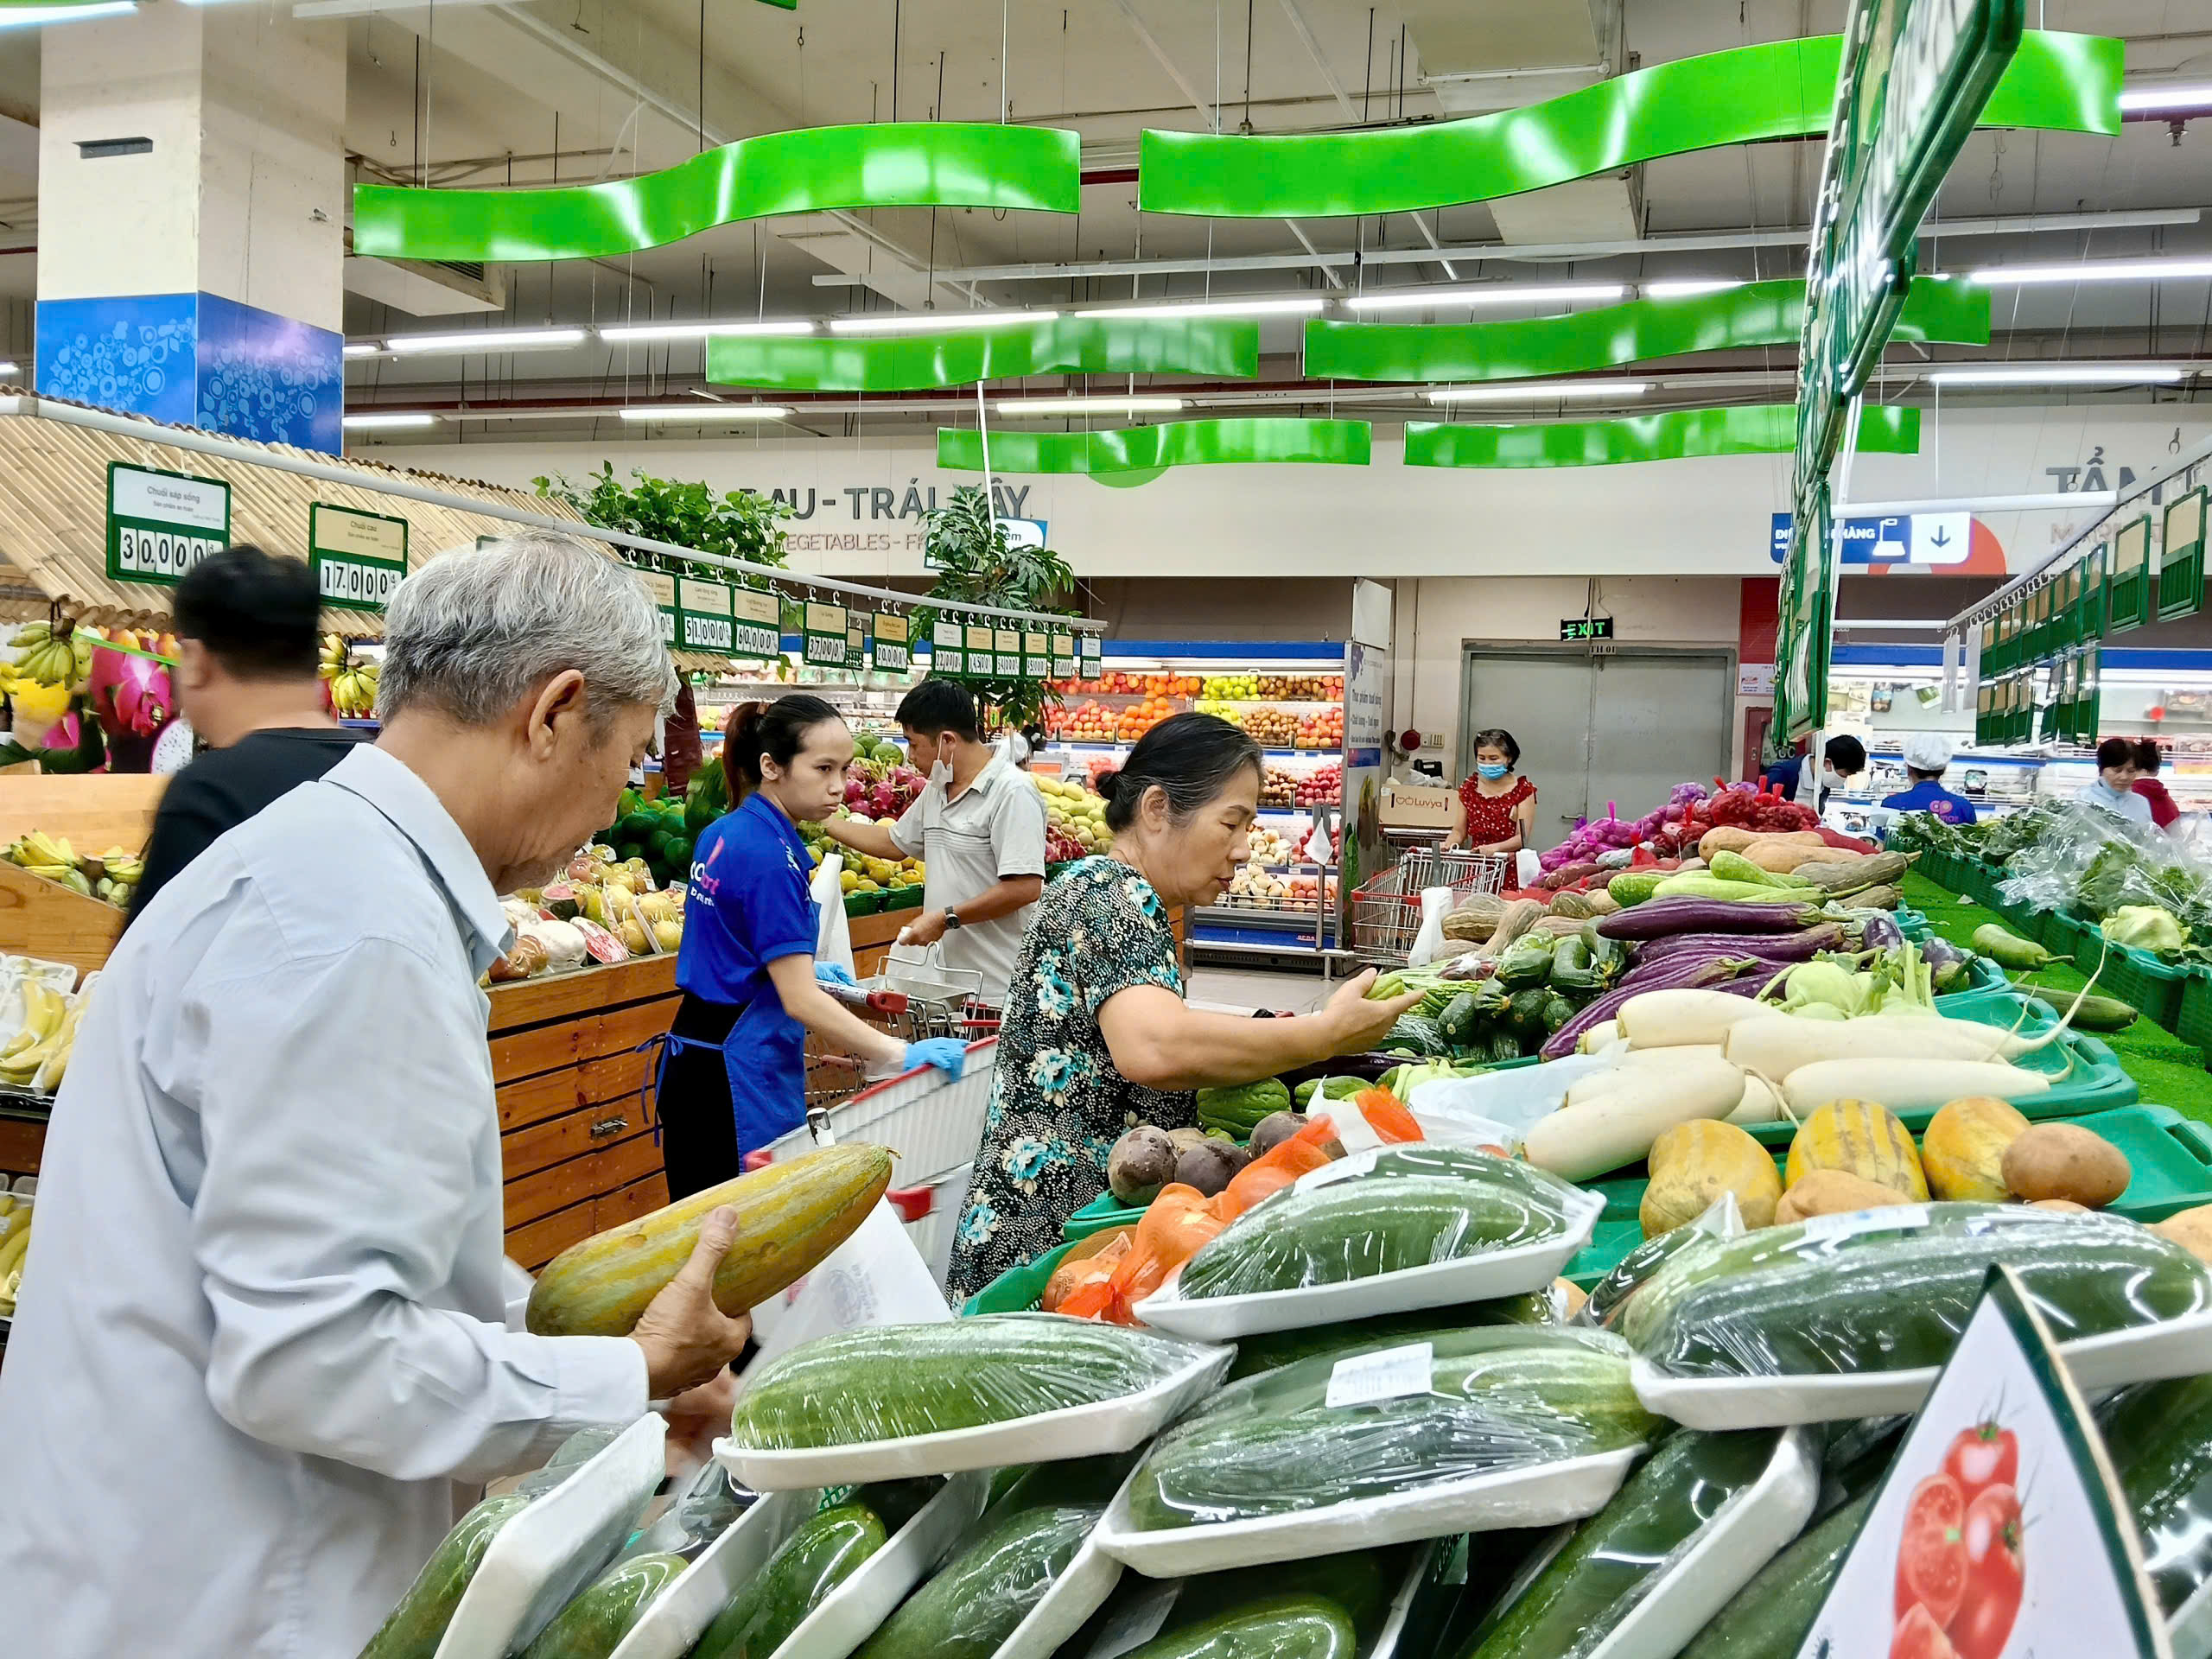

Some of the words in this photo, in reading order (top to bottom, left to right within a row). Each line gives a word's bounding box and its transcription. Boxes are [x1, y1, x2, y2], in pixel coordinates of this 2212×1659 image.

[785, 533, 890, 551] EGETABLES
[325, 566, 388, 594] 17.000
[686, 620, 724, 641] 51.000
[1567, 622, 1605, 636] EXIT
